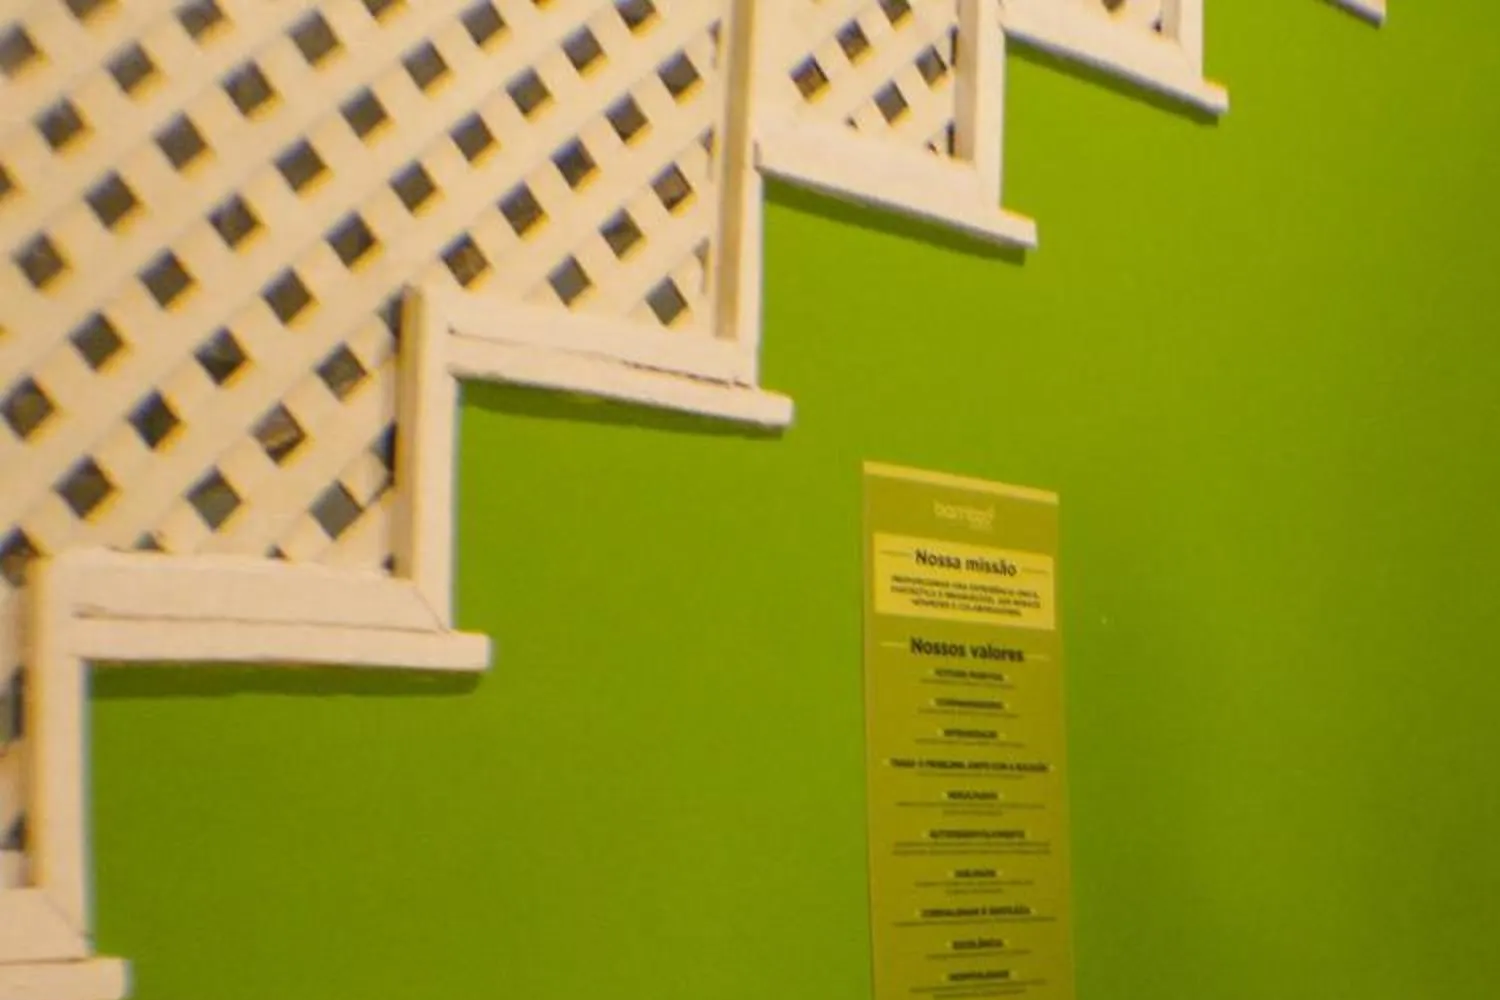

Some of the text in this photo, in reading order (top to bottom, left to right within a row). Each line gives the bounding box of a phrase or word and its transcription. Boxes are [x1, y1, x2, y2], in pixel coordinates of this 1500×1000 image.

[915, 549, 1018, 577] Nossa missão
[910, 635, 1024, 662] Nossos valores
